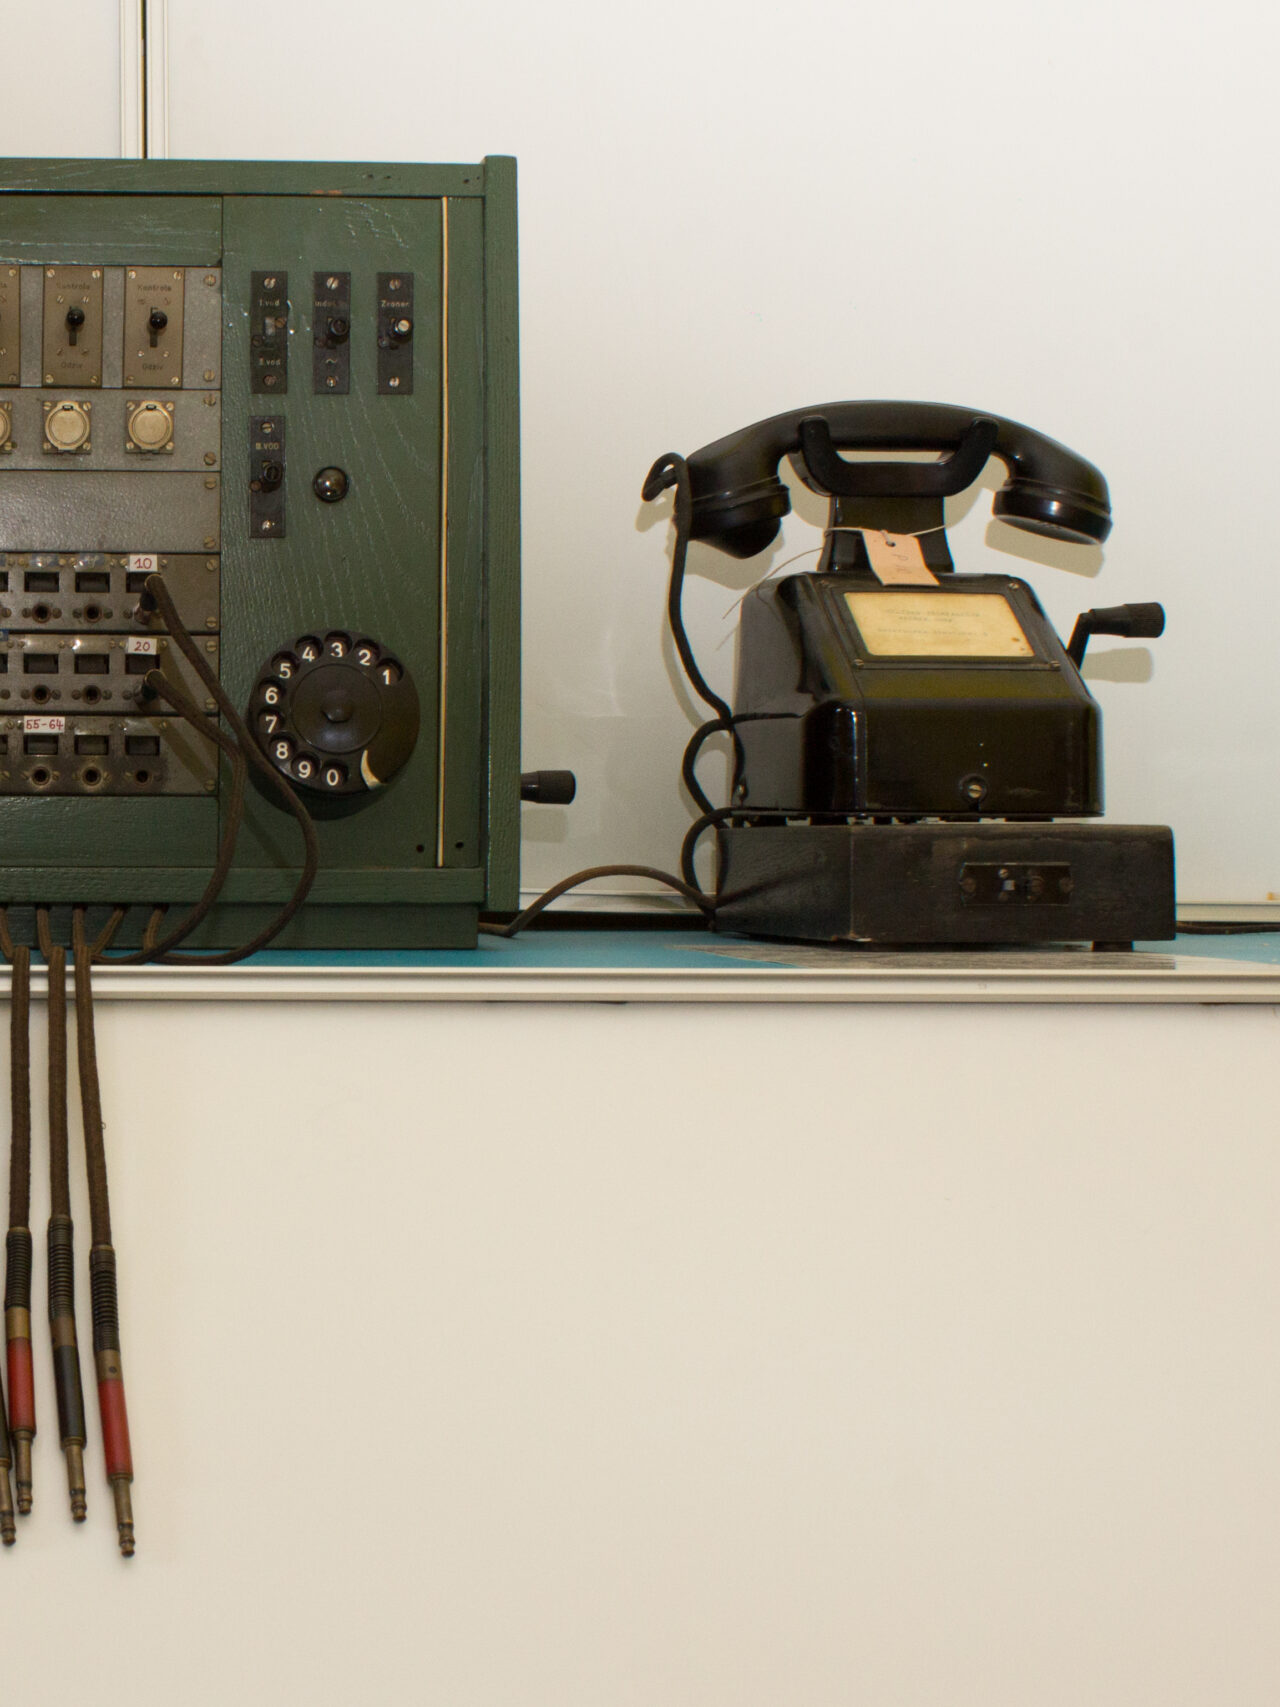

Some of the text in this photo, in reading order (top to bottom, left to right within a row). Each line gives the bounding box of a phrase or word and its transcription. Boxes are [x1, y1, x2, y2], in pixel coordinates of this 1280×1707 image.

[134, 557, 152, 570] 10
[134, 641, 151, 652] 20
[302, 646, 315, 662] 4
[330, 641, 343, 658] 3
[358, 649, 371, 666] 2
[279, 663, 291, 679] 5
[382, 669, 390, 685] 1
[265, 687, 278, 704] 6
[26, 718, 64, 731] 55-64
[265, 716, 277, 733] 7
[276, 742, 289, 759] 8
[298, 761, 311, 778] 9
[326, 769, 339, 786] 0
